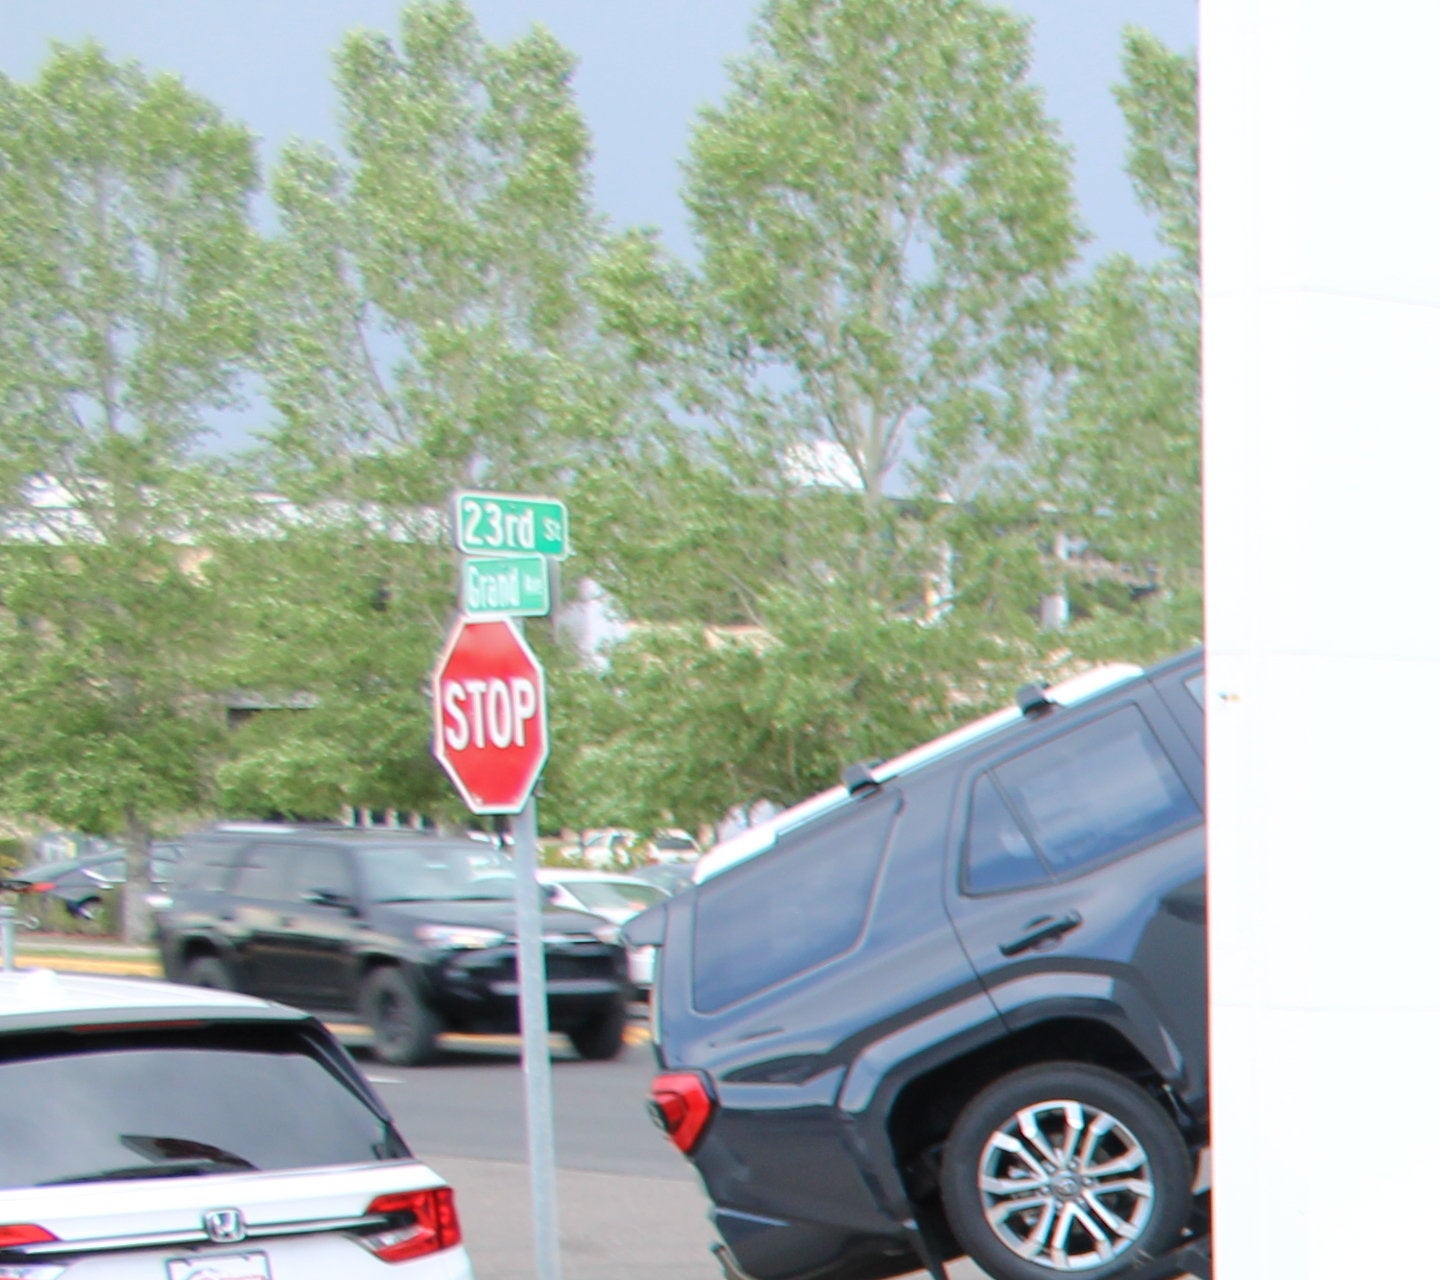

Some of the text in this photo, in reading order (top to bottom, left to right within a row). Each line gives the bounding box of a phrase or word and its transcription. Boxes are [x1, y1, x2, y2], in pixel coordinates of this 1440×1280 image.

[463, 500, 535, 549] 23rd
[467, 565, 520, 609] Grand
[443, 677, 536, 751] STOP
